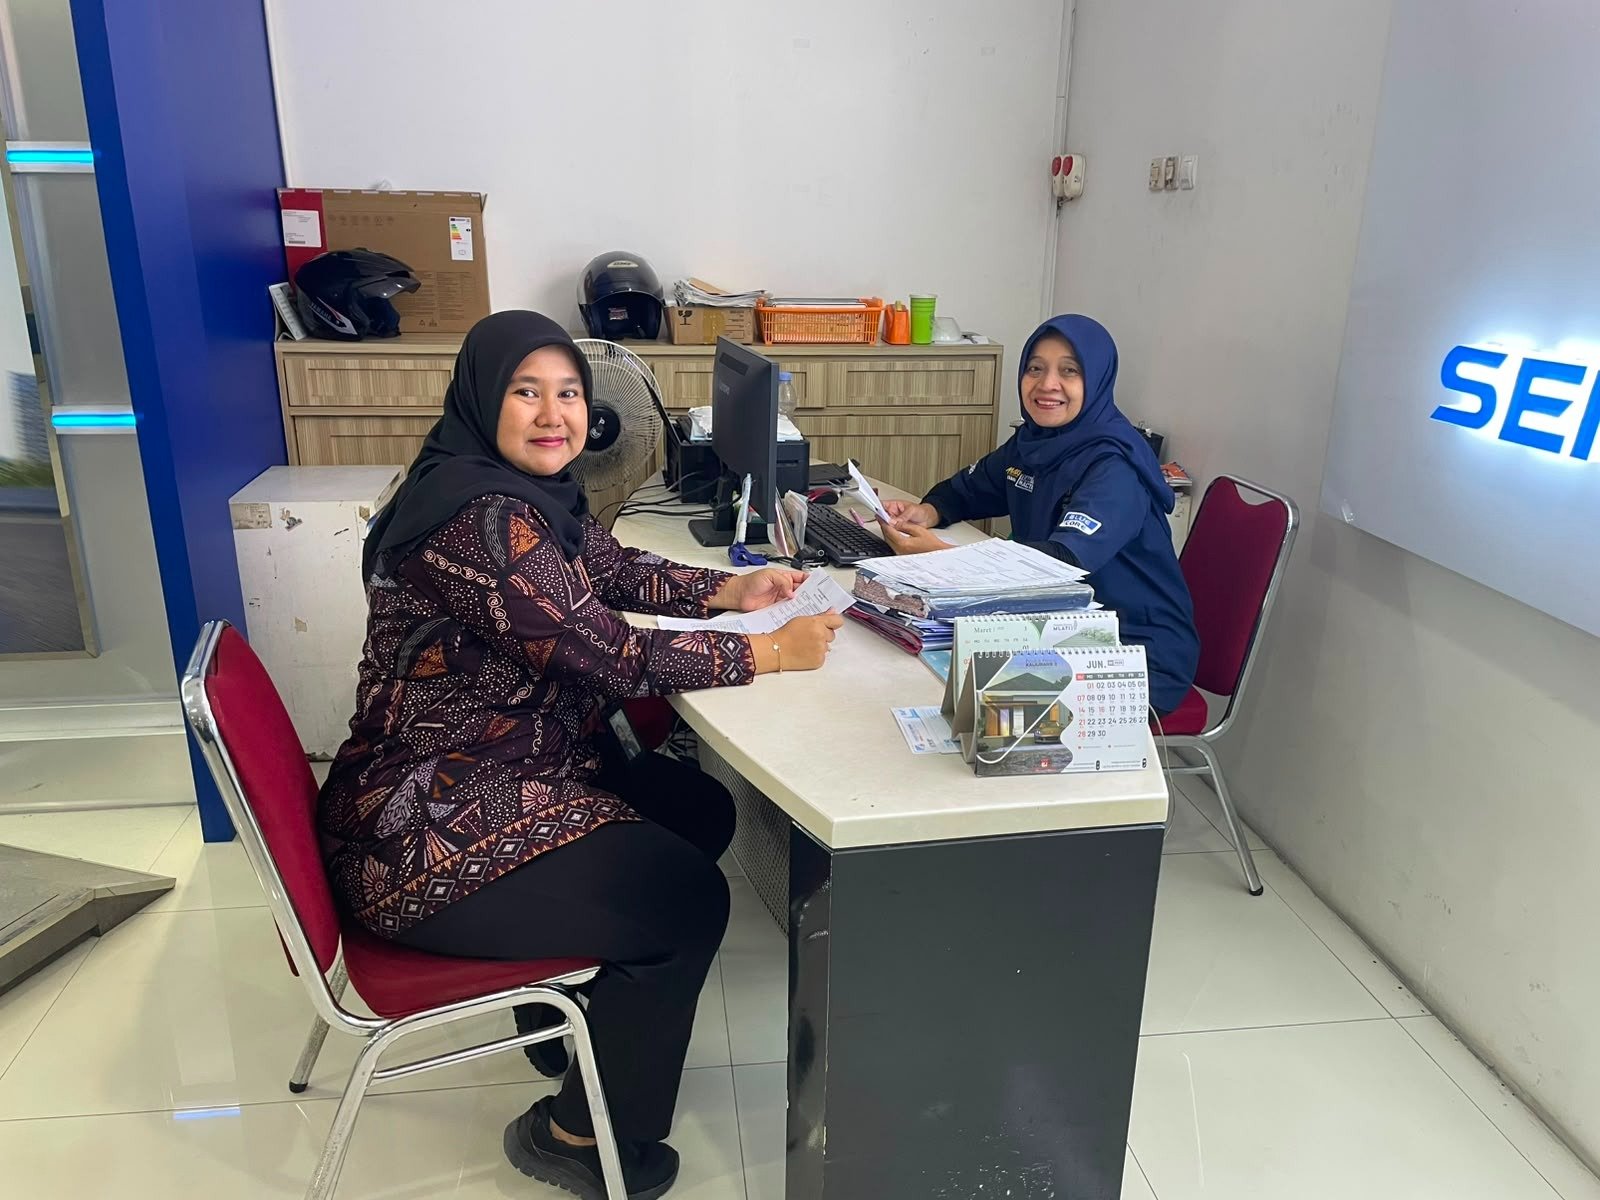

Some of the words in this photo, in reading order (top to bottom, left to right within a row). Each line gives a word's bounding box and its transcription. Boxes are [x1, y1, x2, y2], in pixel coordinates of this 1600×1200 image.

[1065, 520, 1087, 531] CORE
[1068, 514, 1091, 526] BLUE
[1086, 660, 1106, 668] JUN.
